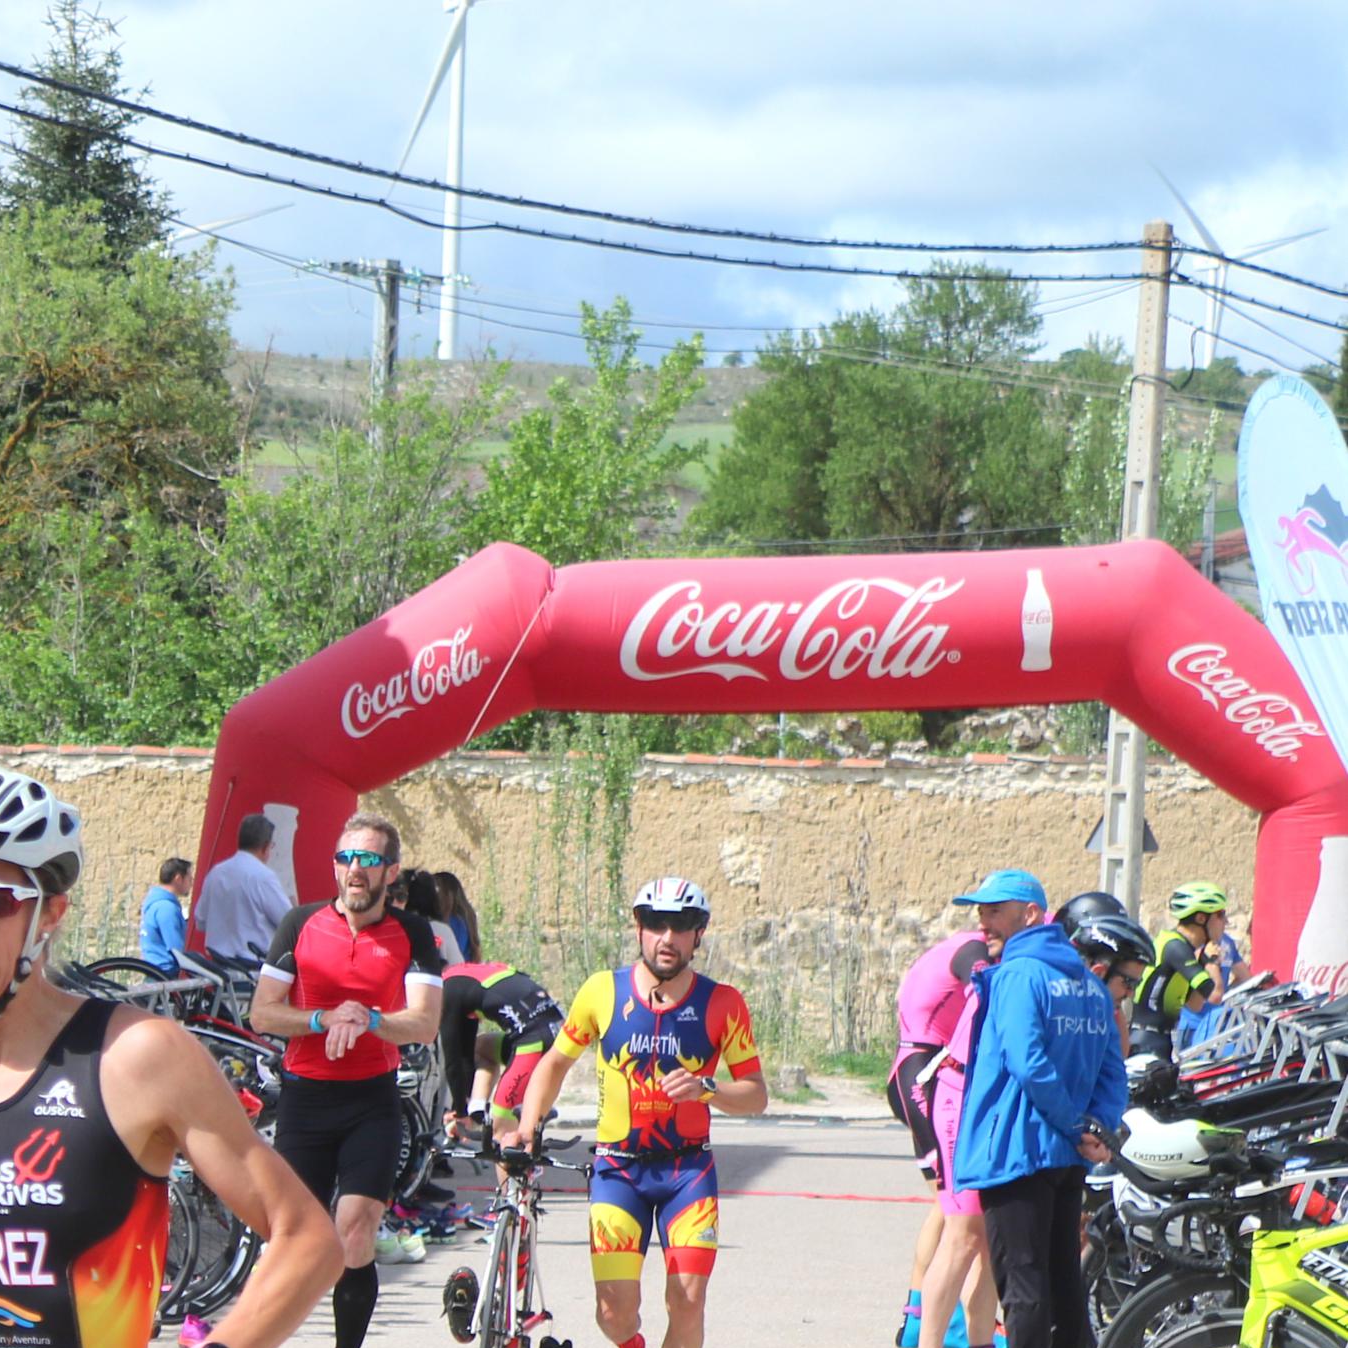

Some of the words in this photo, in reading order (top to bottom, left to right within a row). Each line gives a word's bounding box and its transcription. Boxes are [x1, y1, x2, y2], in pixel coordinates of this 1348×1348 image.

[341, 622, 484, 739] Coca-Cola
[620, 577, 965, 682] Coca-Cola
[1167, 642, 1326, 762] Coca-Cola
[629, 1032, 681, 1055] MARTÍN
[12, 1335, 51, 1346] Aventura
